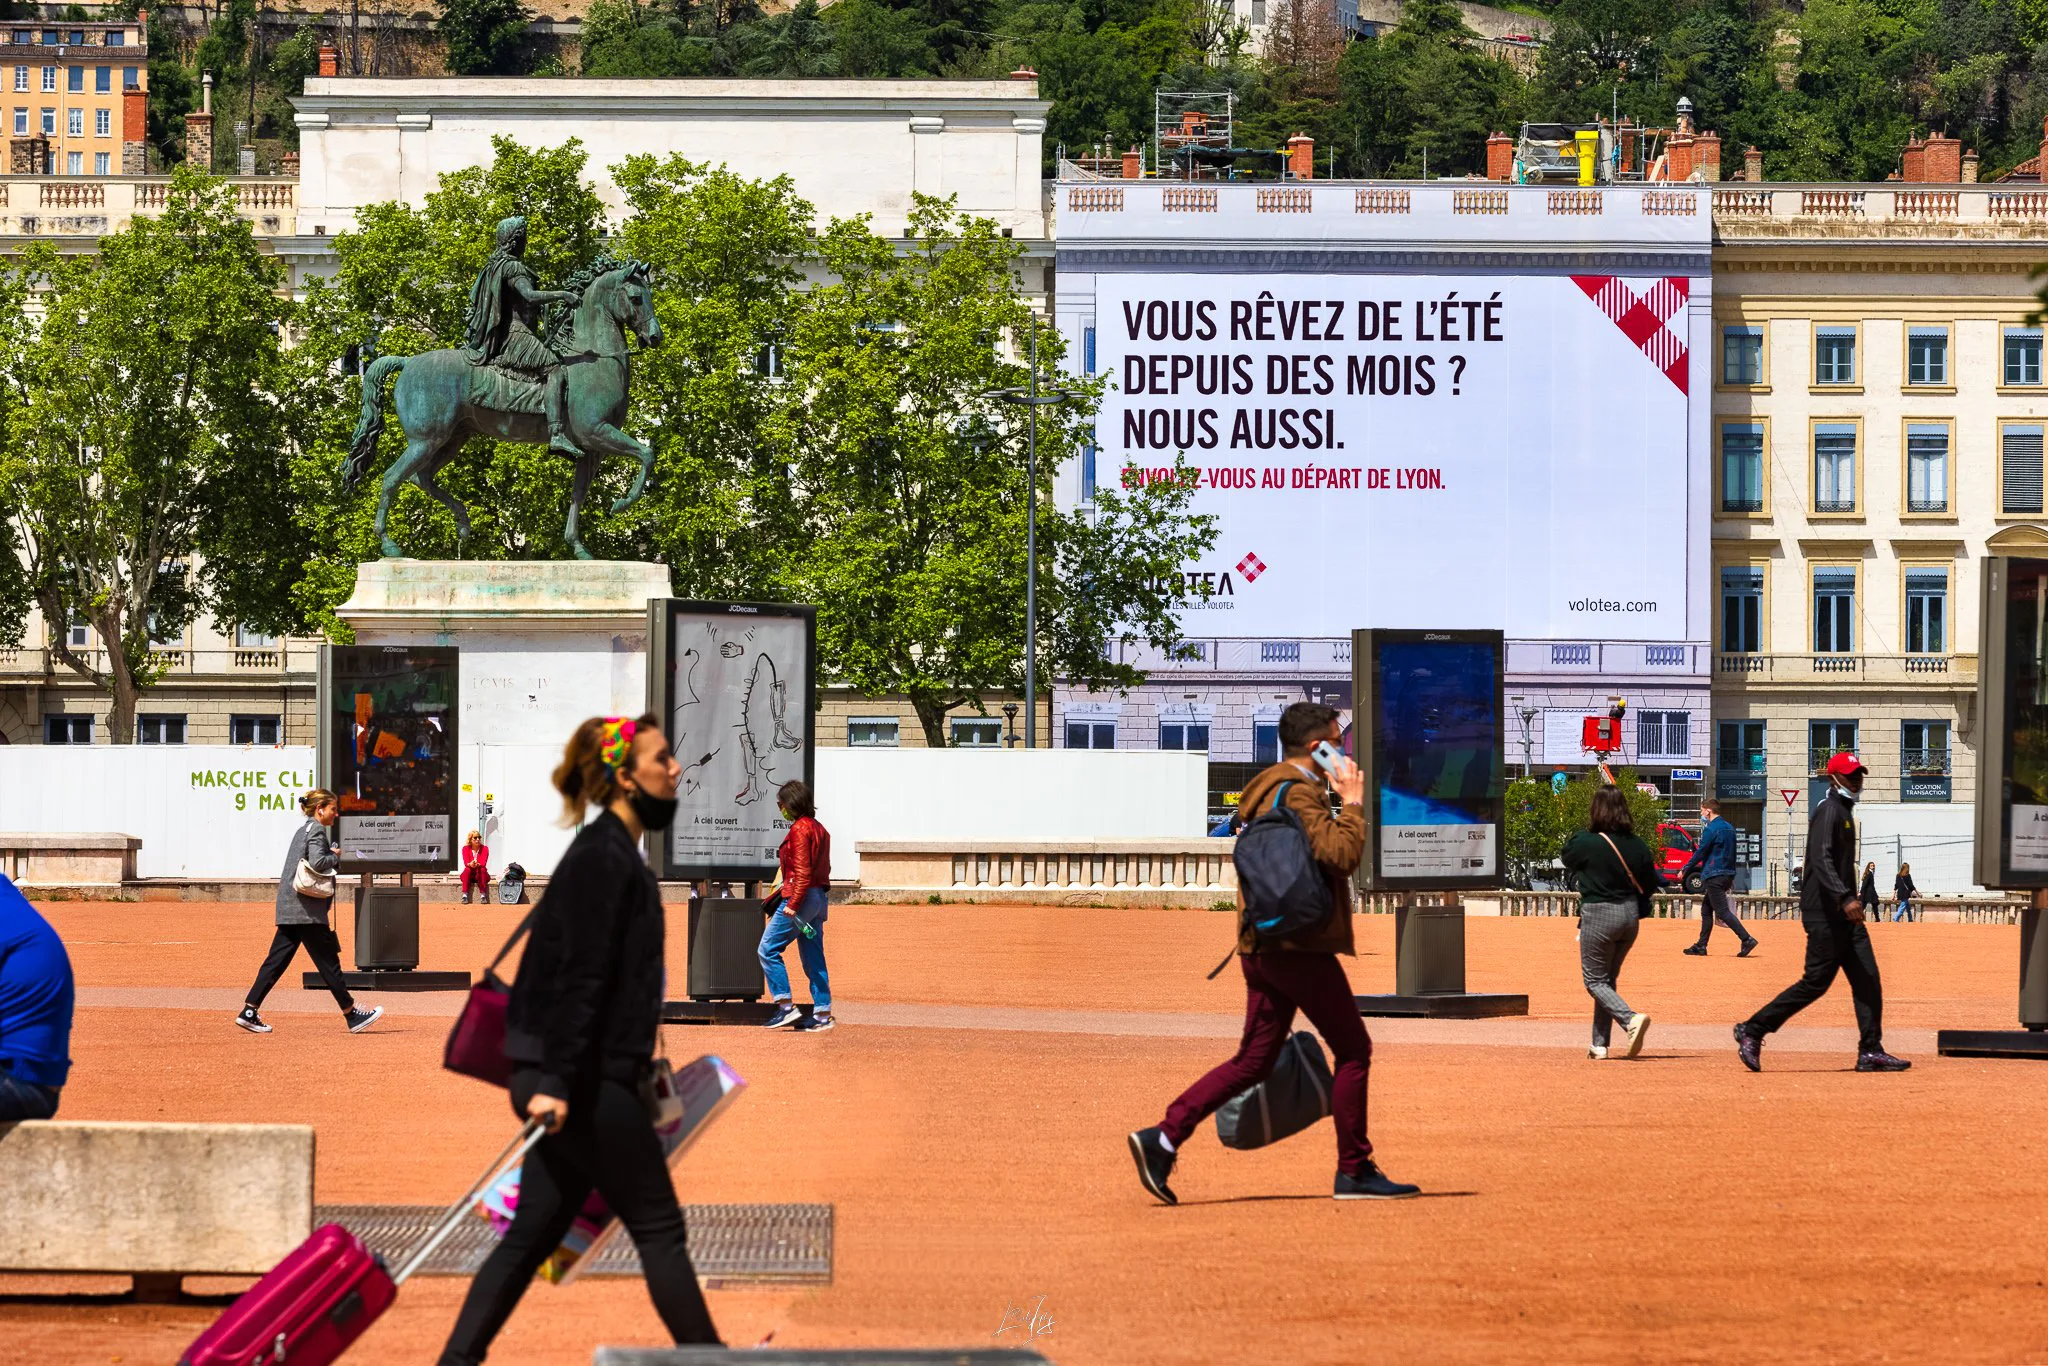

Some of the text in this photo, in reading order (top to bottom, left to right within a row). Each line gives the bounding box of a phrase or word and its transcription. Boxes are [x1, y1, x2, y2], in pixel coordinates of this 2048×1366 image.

[1123, 300, 1217, 341] VOUS
[1231, 291, 1344, 341] RÊVEZ
[1358, 300, 1402, 341] DE
[1124, 354, 1466, 396] DEPUIS DES MOIS ?
[1123, 409, 1344, 450] NOUS AUSSI.
[1262, 468, 1285, 489] AU
[1291, 463, 1362, 489] DÉPART
[1368, 468, 1391, 489] DE
[1396, 468, 1446, 490] LYON.
[728, 604, 758, 613] JCDecaux
[1207, 602, 1234, 610] VOLOTEA
[1569, 598, 1657, 613] volotea.com
[191, 770, 267, 788] MARCHE
[235, 793, 246, 811] 9
[365, 820, 376, 828] ciel
[694, 815, 700, 824] À
[701, 816, 713, 824] ciel
[1404, 830, 1415, 838] ciel
